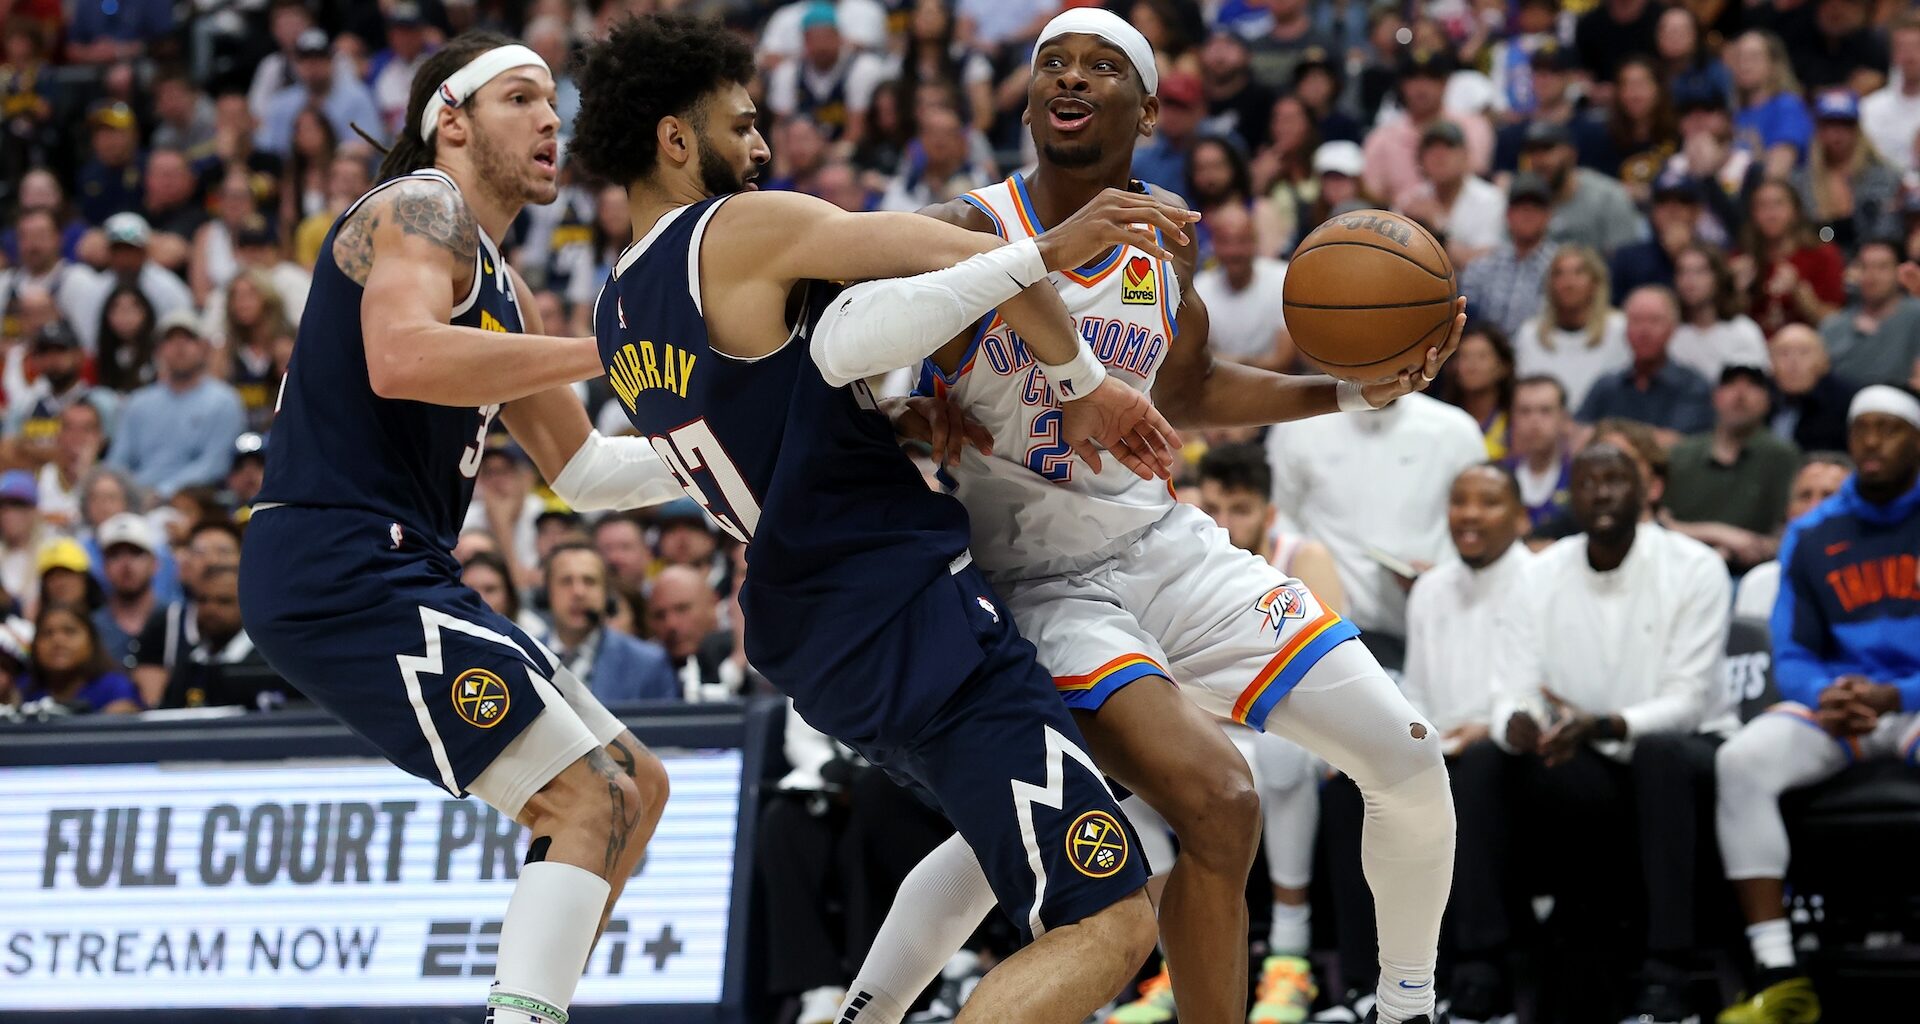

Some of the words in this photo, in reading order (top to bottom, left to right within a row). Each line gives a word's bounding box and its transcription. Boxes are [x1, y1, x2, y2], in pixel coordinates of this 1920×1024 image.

[609, 340, 697, 415] MURRAY
[982, 316, 1165, 380] OKHOMA
[650, 416, 762, 544] 27
[1024, 408, 1074, 484] 2
[42, 806, 178, 888] FULL
[199, 800, 417, 887] COURT
[5, 930, 227, 976] STREAM
[248, 926, 380, 971] NOW
